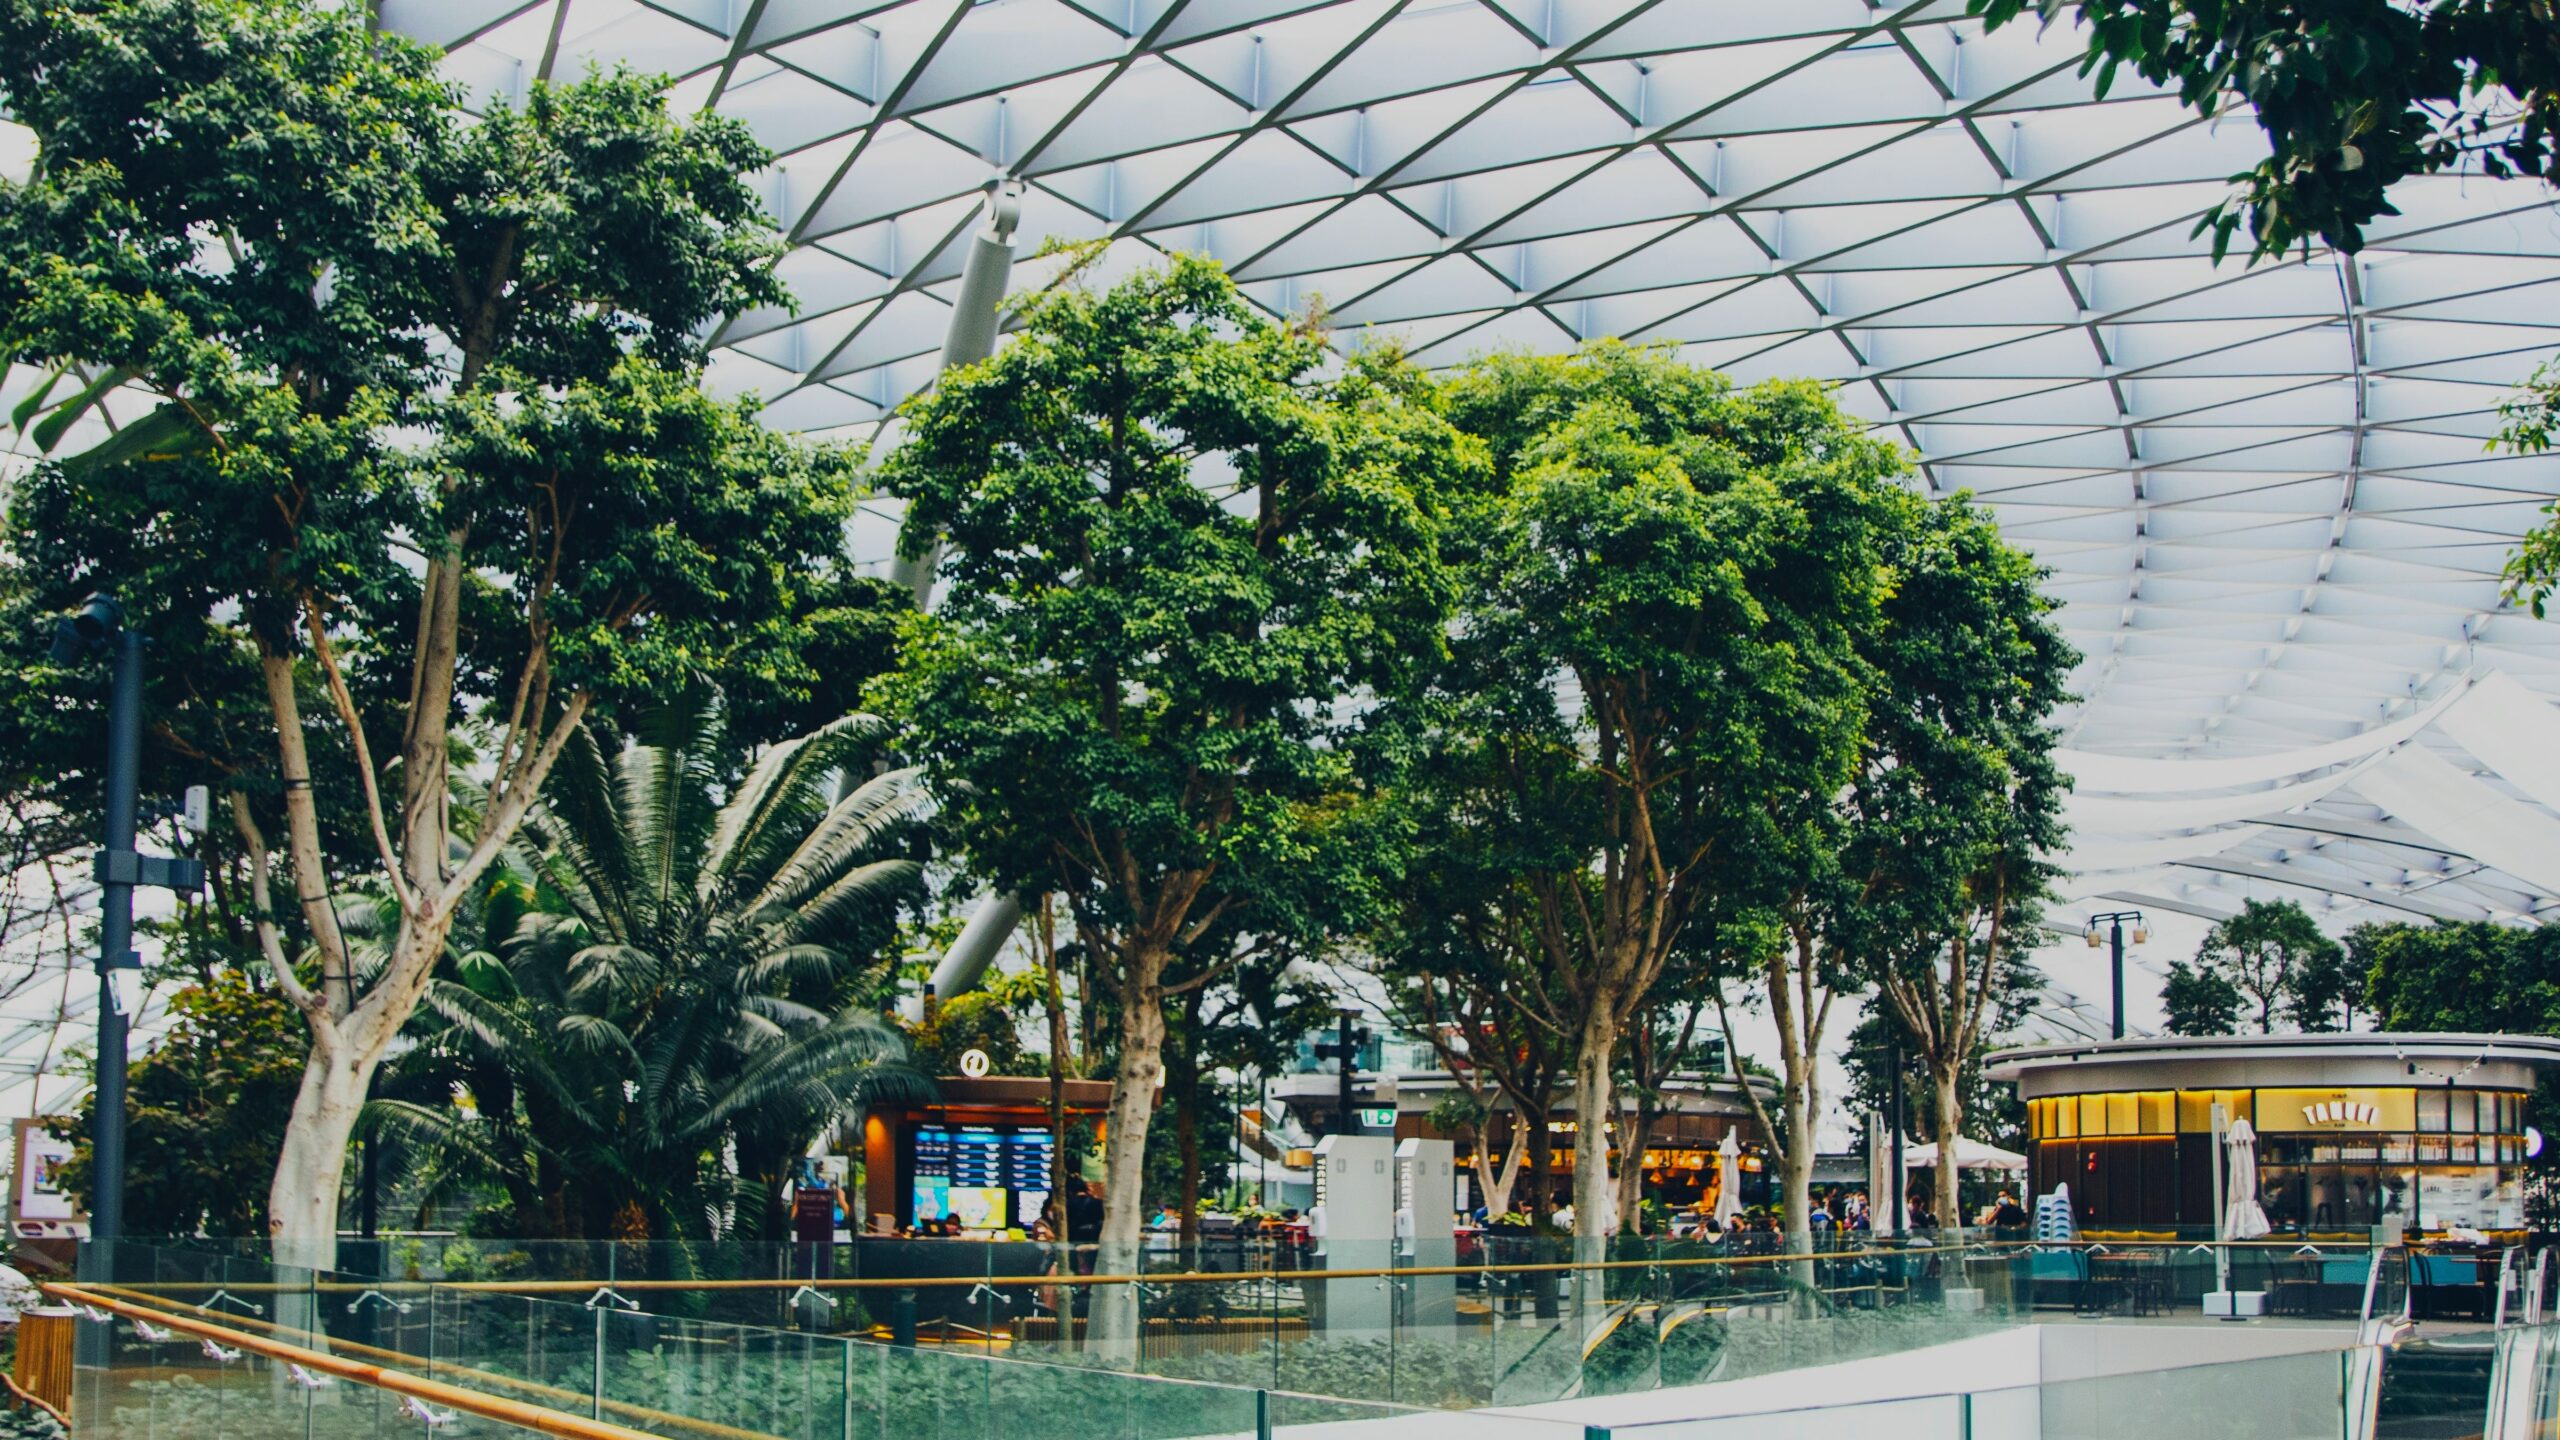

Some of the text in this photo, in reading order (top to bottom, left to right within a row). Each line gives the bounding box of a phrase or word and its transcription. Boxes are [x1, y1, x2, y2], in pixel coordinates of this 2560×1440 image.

[2302, 1101, 2379, 1125] TANUKI
[1316, 1158, 1326, 1208] TICKETS
[1401, 1161, 1412, 1208] TICKETS
